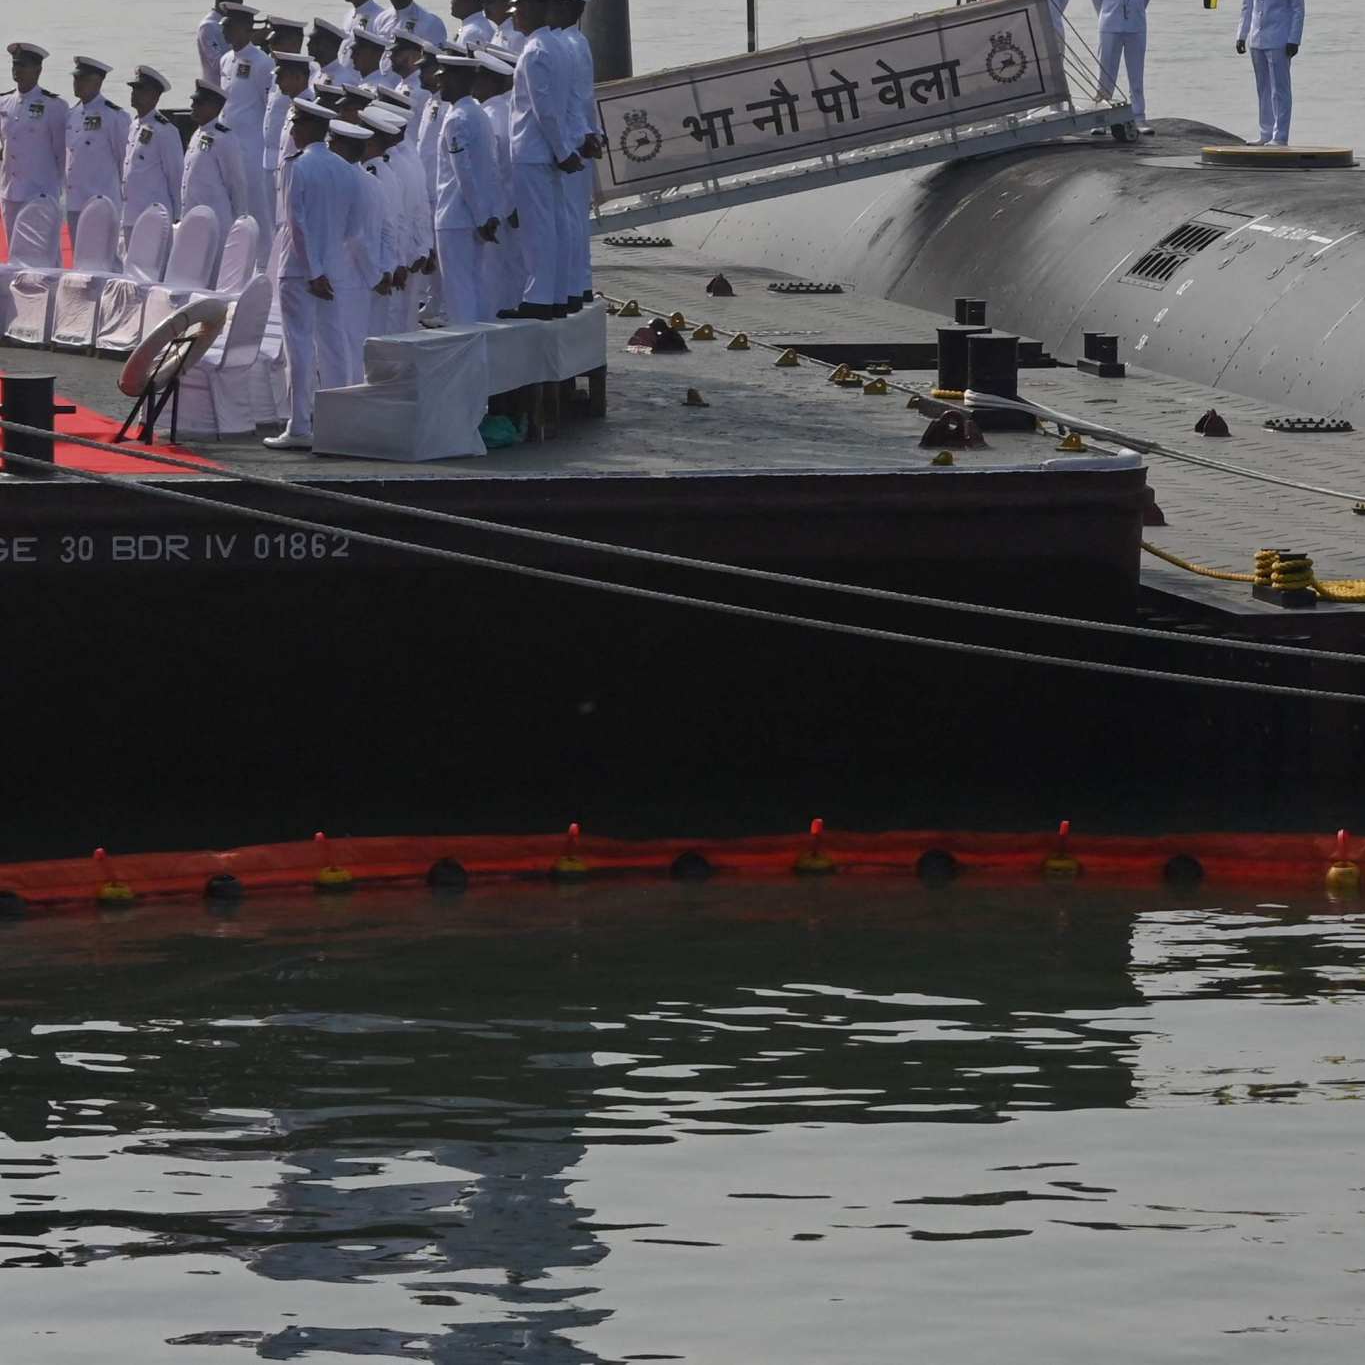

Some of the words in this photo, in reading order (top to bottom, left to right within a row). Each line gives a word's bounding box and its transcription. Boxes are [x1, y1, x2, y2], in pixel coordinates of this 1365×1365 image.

[682, 106, 736, 149] भा
[745, 78, 799, 136] नौ
[811, 68, 859, 123] पो
[871, 58, 961, 110] वेला
[60, 536, 94, 564] 30
[112, 536, 191, 562] BDR
[205, 534, 238, 560] IV
[254, 533, 350, 560] 01862
